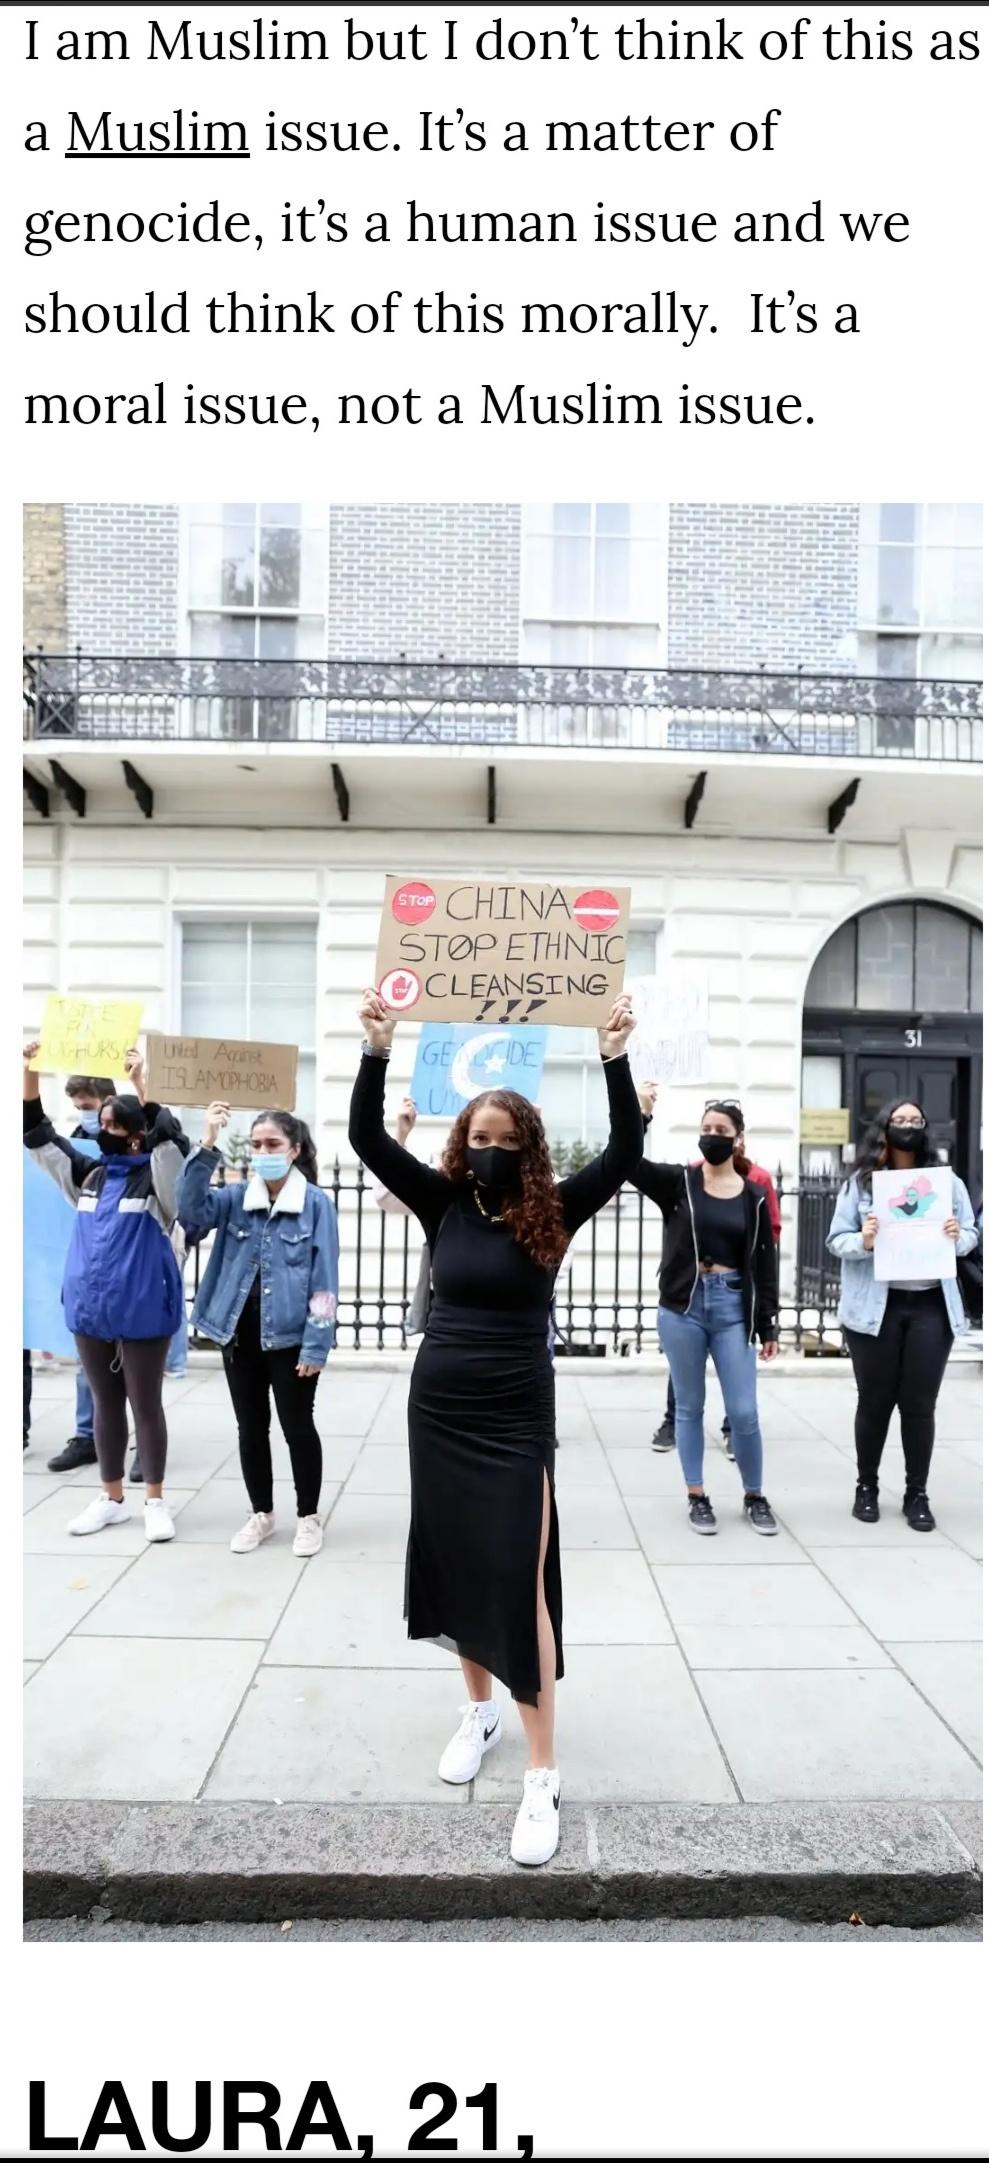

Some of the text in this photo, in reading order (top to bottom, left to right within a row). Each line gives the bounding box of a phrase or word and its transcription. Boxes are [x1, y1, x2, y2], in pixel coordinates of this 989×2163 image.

[398, 893, 435, 907] STOP
[446, 886, 572, 921] CHINA
[505, 931, 625, 965] ETHNIC
[425, 972, 609, 999] CLEANSING
[904, 1029, 922, 1048] 31
